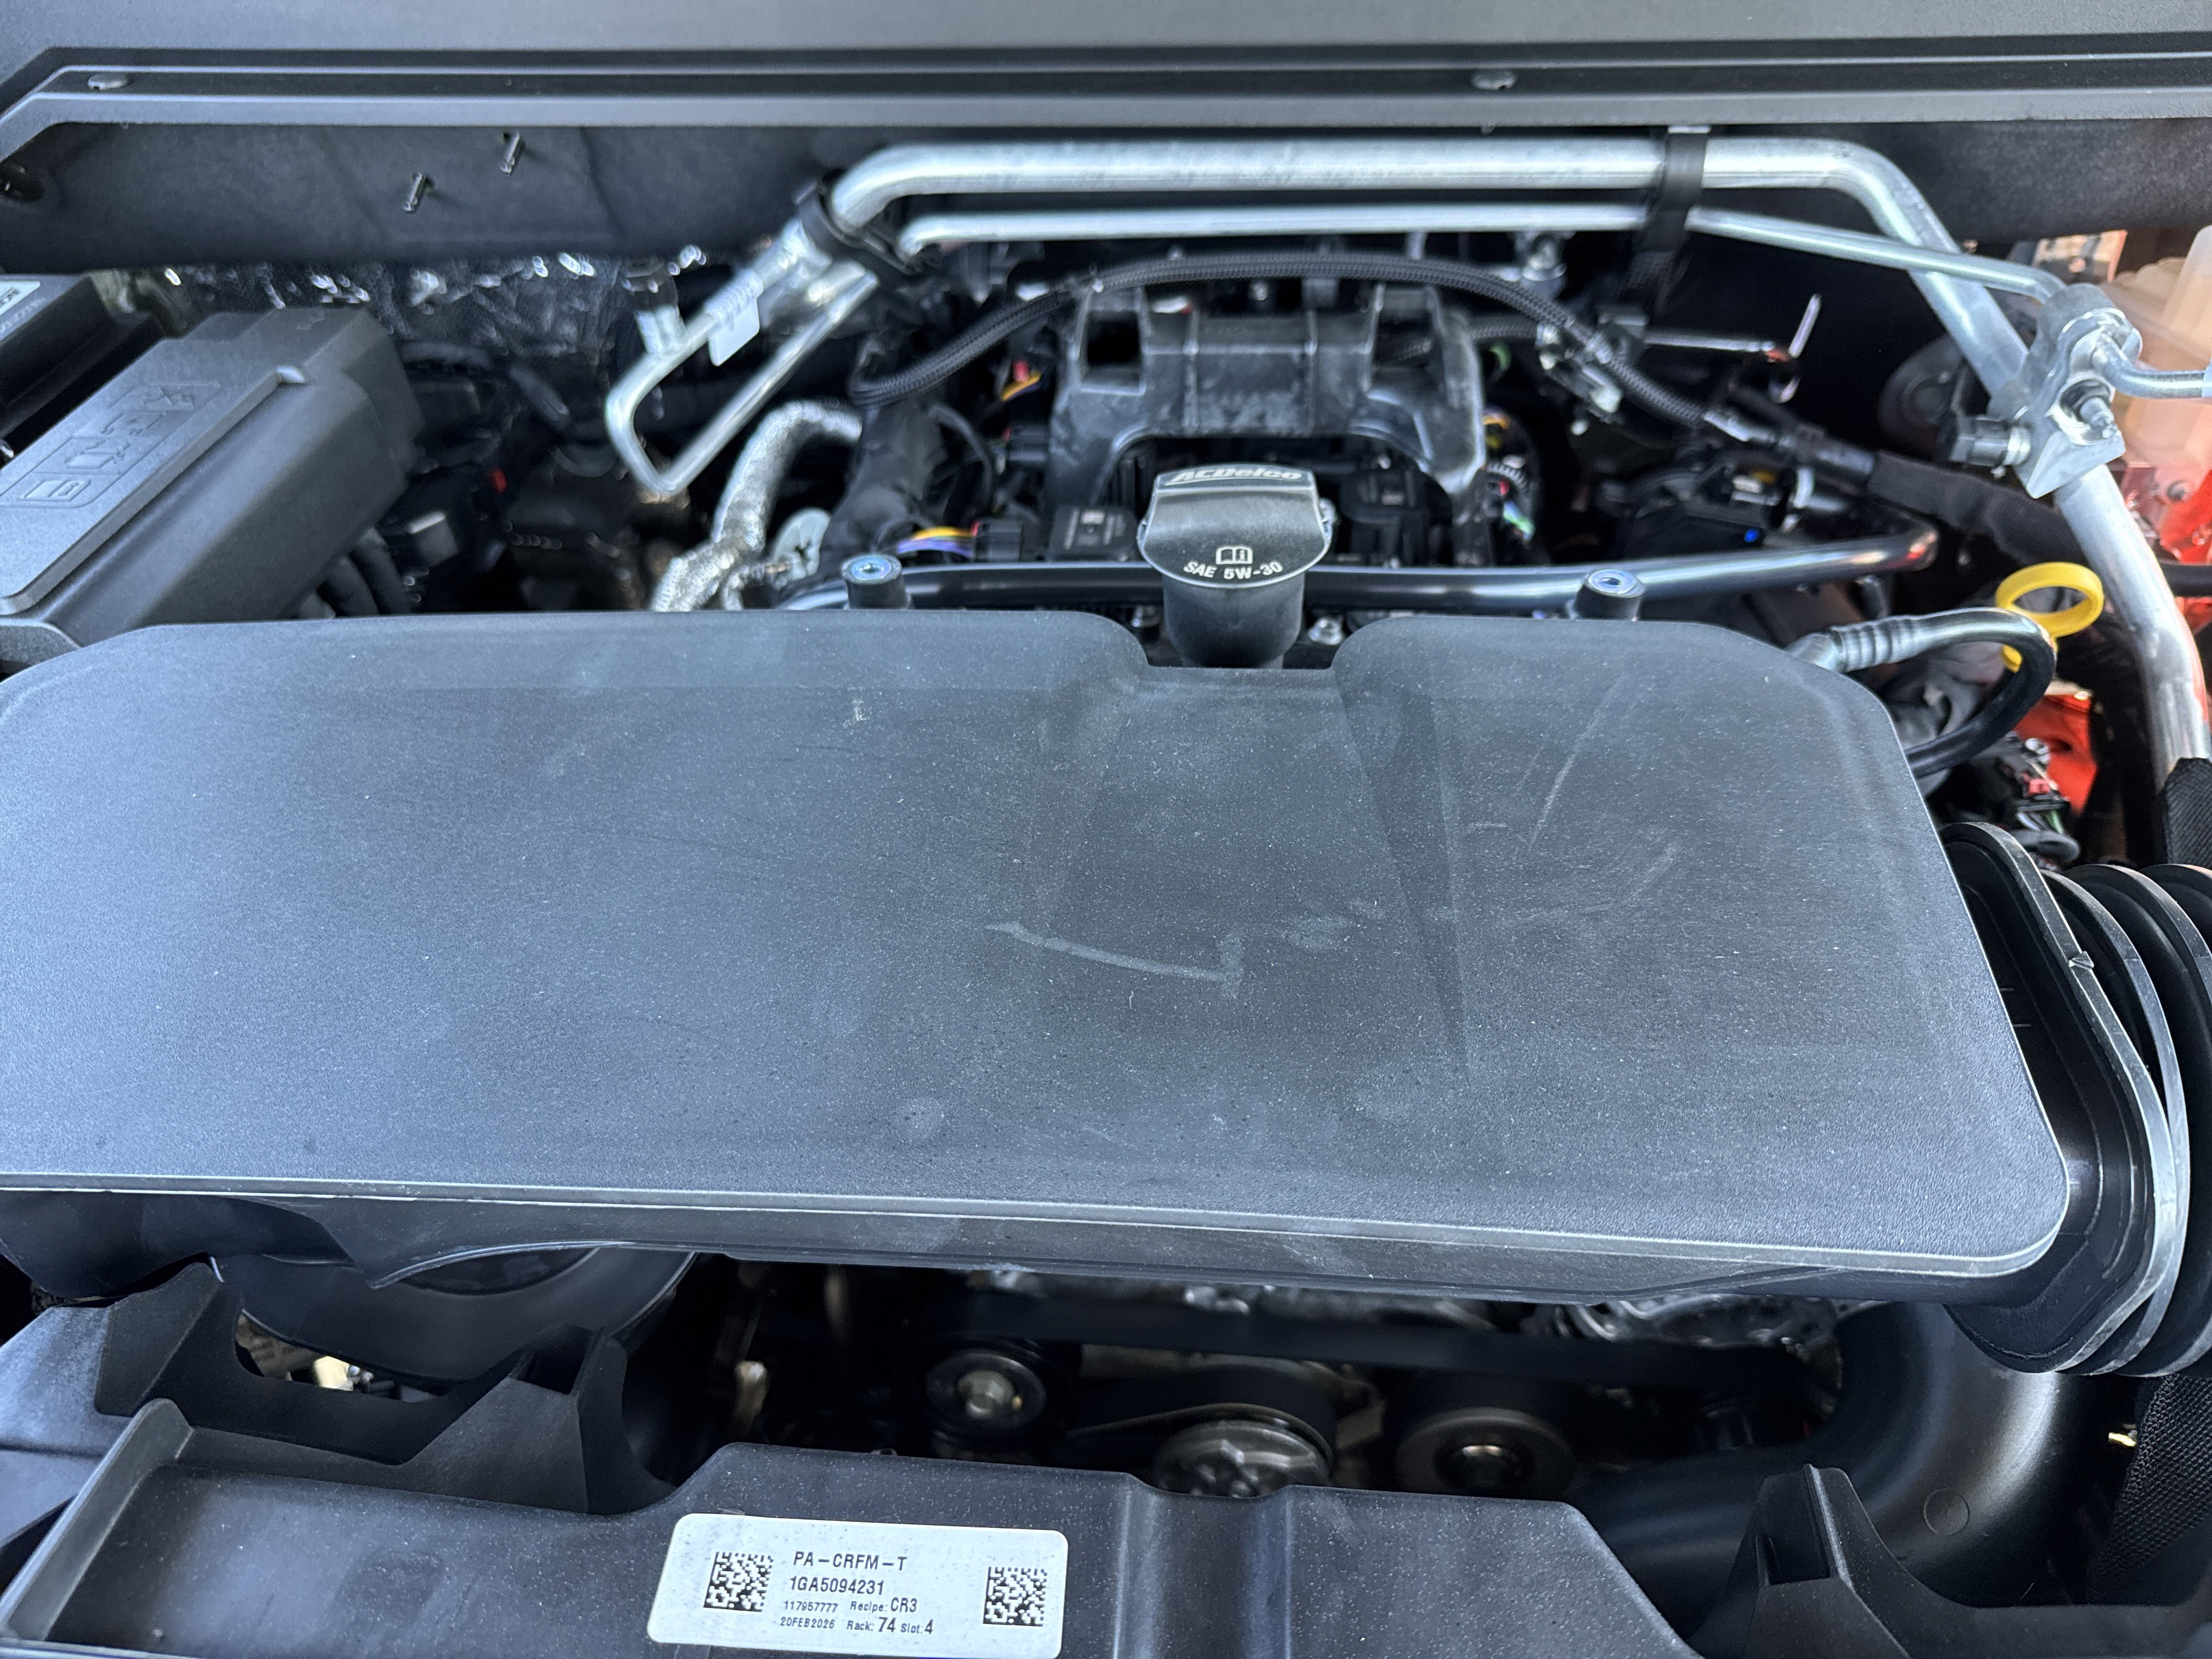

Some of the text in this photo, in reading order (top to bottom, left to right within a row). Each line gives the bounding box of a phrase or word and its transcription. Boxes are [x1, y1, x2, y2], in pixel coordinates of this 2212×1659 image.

[1166, 468, 1302, 485] ACDelco
[1183, 560, 1283, 579] SAE 5W-30
[790, 1576, 884, 1595] 1GA5094231
[784, 1597, 917, 1613] 117957777 Recipe: CR3
[780, 1616, 934, 1634] 20FEB2026 Rack: 74 Slot: 4
